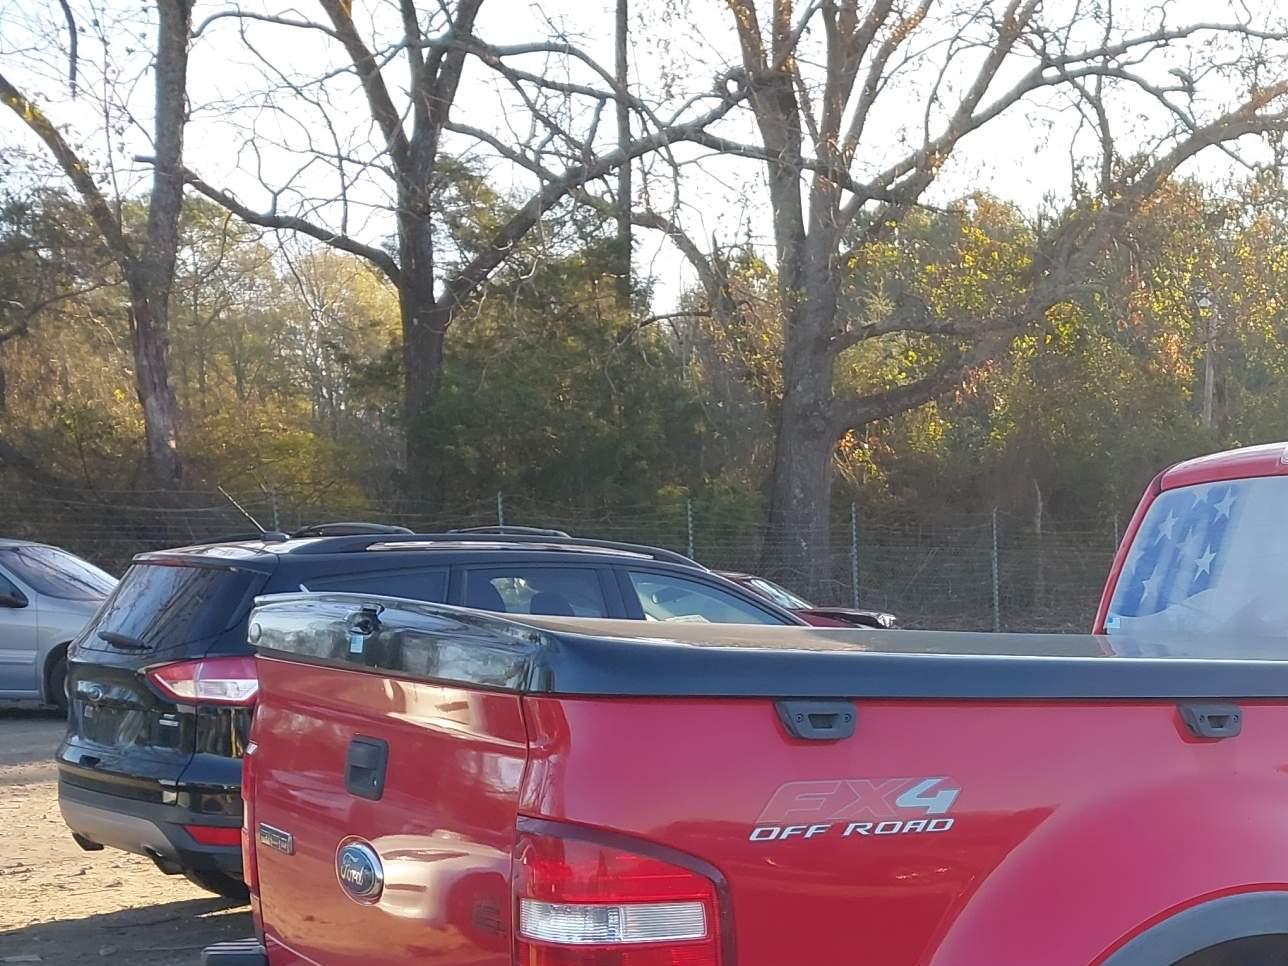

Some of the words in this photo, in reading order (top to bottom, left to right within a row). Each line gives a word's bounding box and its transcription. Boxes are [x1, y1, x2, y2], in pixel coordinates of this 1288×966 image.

[755, 776, 961, 824] FX4
[749, 824, 832, 842] OFF
[843, 818, 955, 837] ROAD
